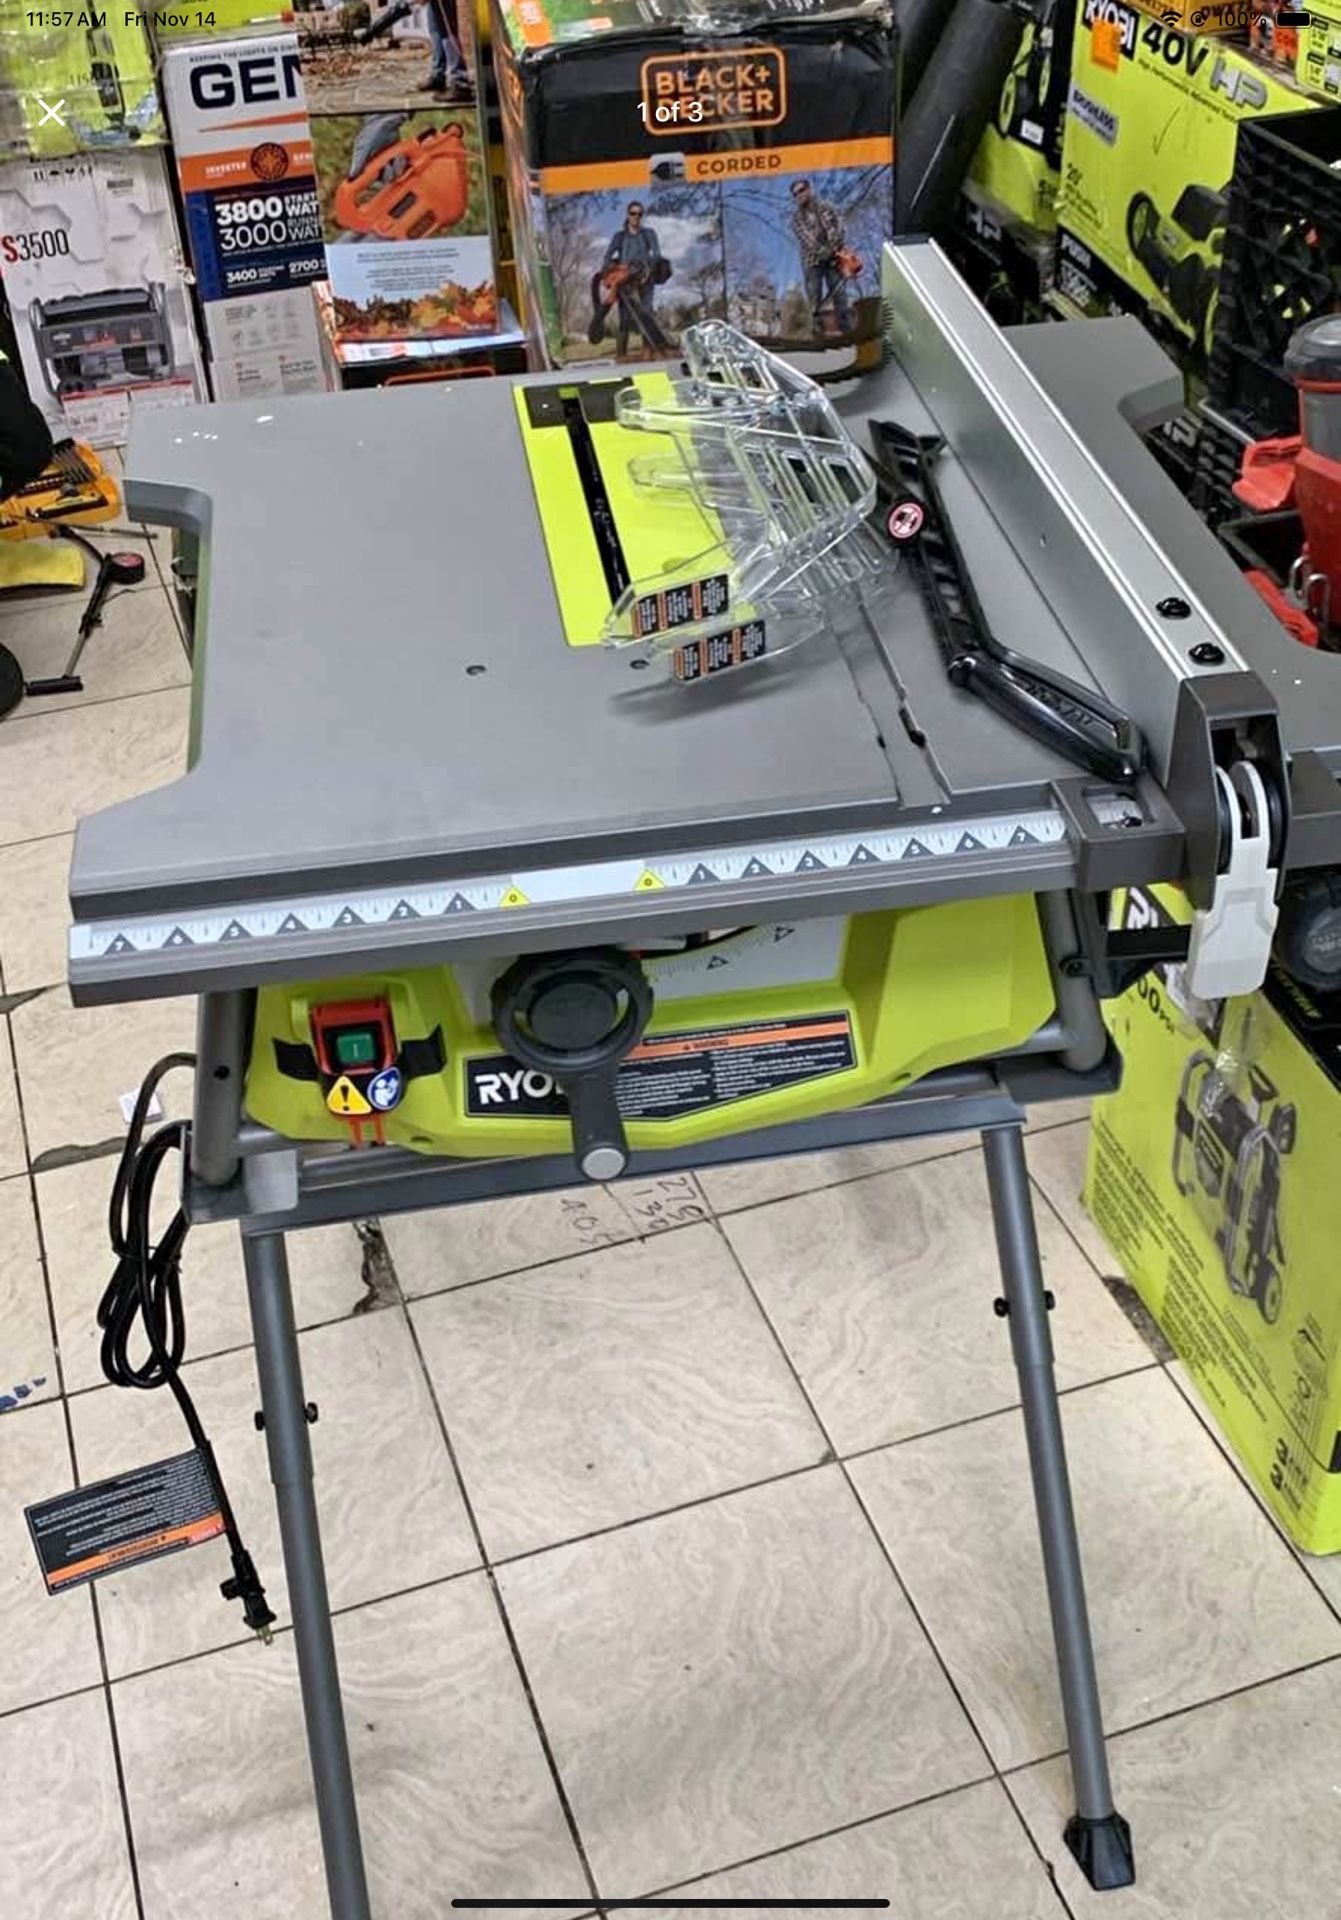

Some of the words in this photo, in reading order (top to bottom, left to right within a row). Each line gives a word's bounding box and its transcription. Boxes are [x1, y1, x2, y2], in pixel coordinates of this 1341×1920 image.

[1142, 22, 1209, 76] 40V
[1210, 56, 1267, 110] HP
[657, 89, 774, 120] DECKER
[696, 154, 782, 175] CORDED
[215, 196, 283, 226] 3800
[219, 220, 287, 250] 3000
[289, 259, 319, 273] 2700
[474, 1069, 569, 1105] RYO
